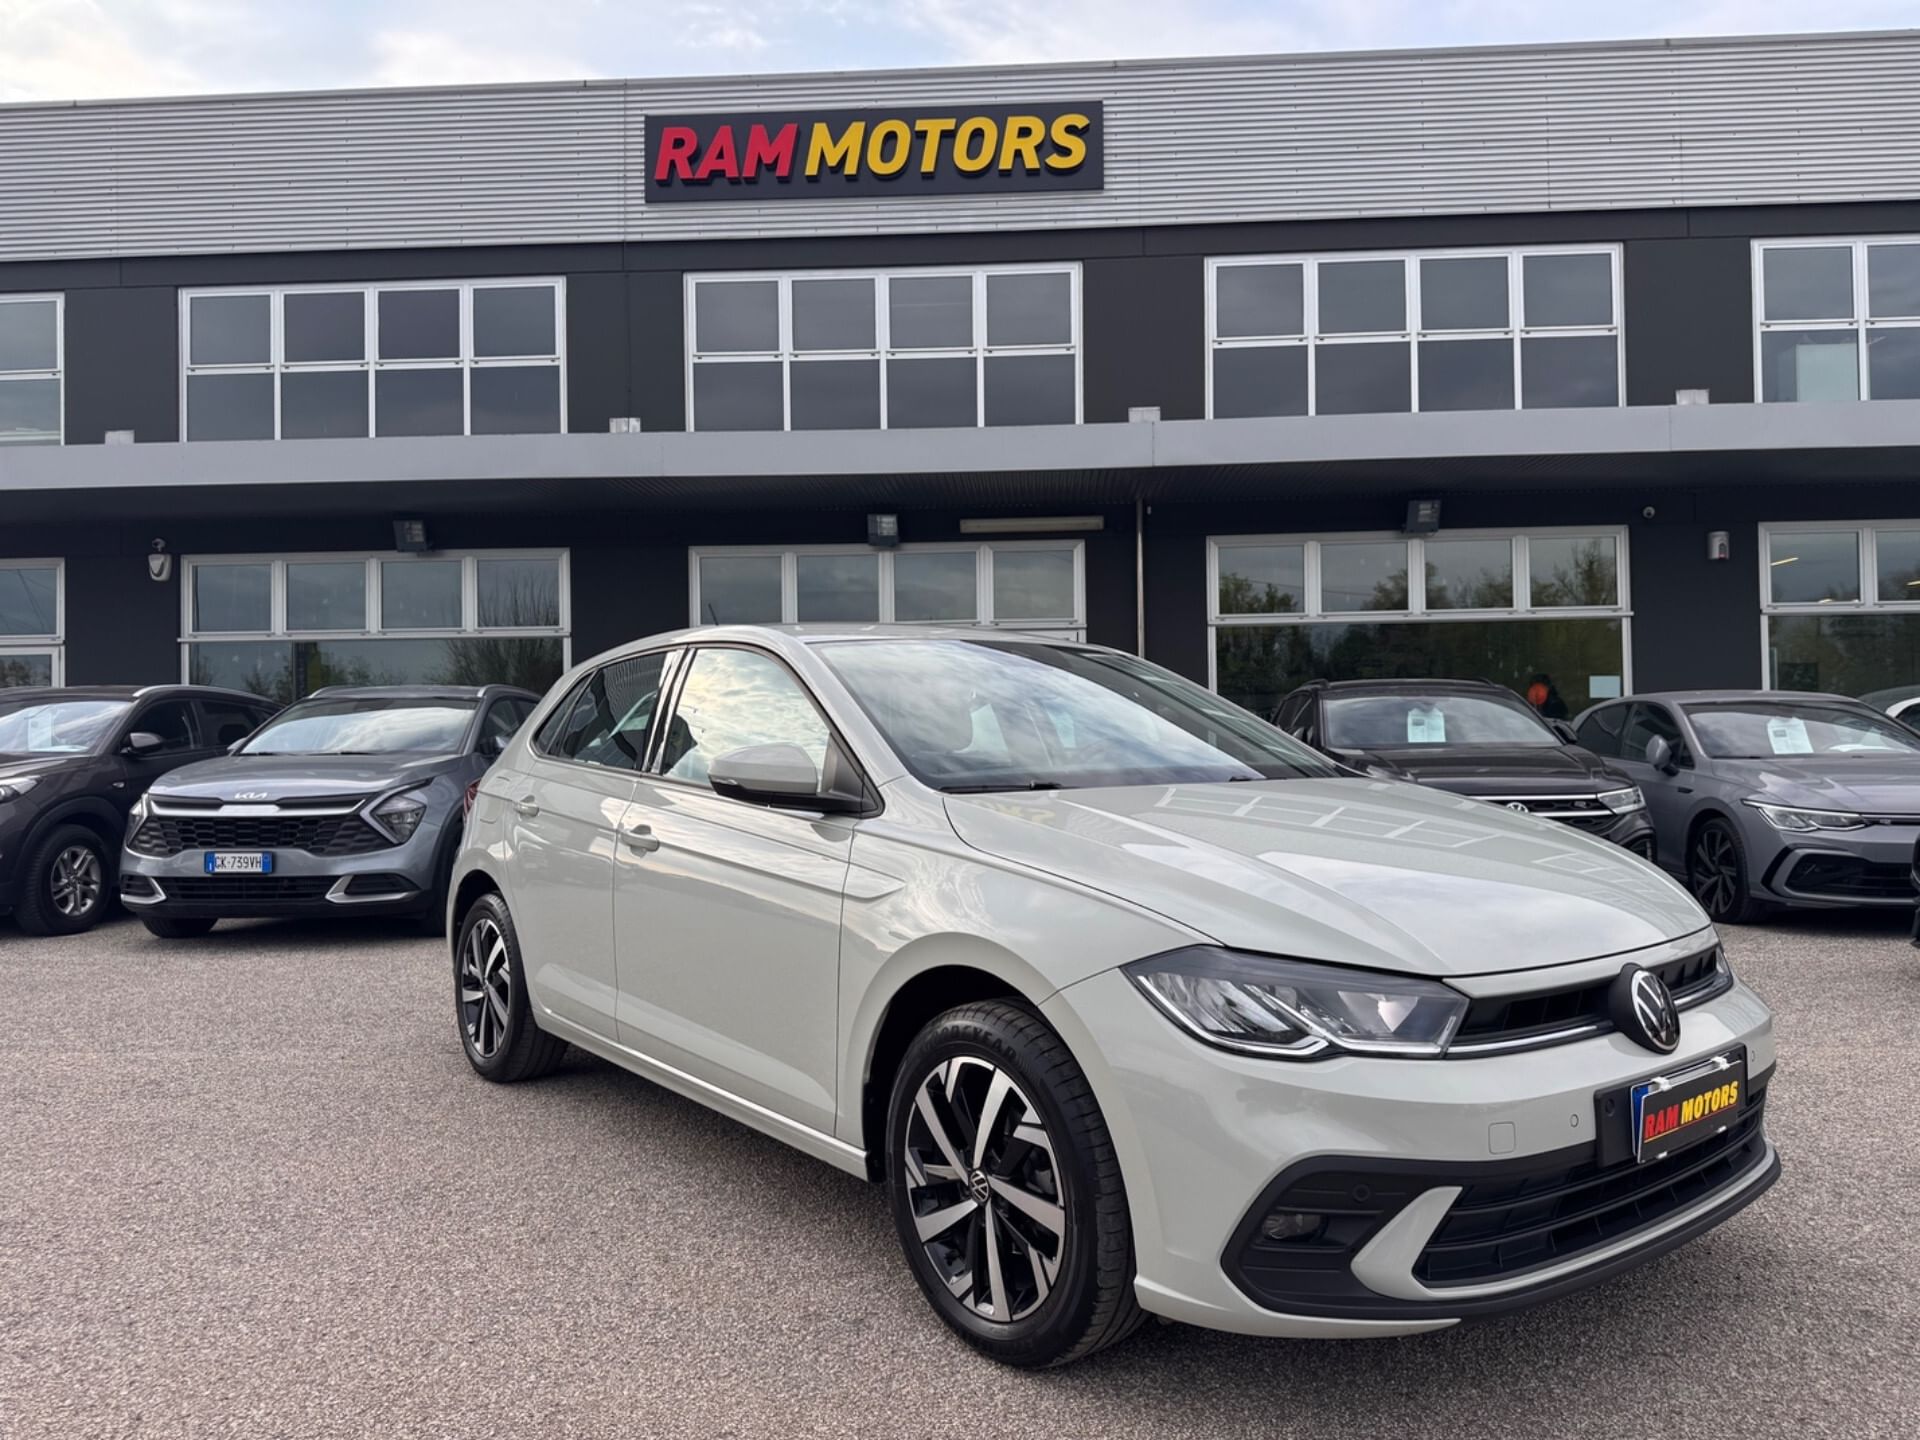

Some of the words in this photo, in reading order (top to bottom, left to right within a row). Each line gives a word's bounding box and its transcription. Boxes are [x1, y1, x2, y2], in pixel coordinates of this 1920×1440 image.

[654, 122, 798, 182] RAM
[804, 113, 1090, 178] MOTORS
[1643, 1103, 1679, 1140] RAM
[1680, 1081, 1739, 1125] MOTORS
